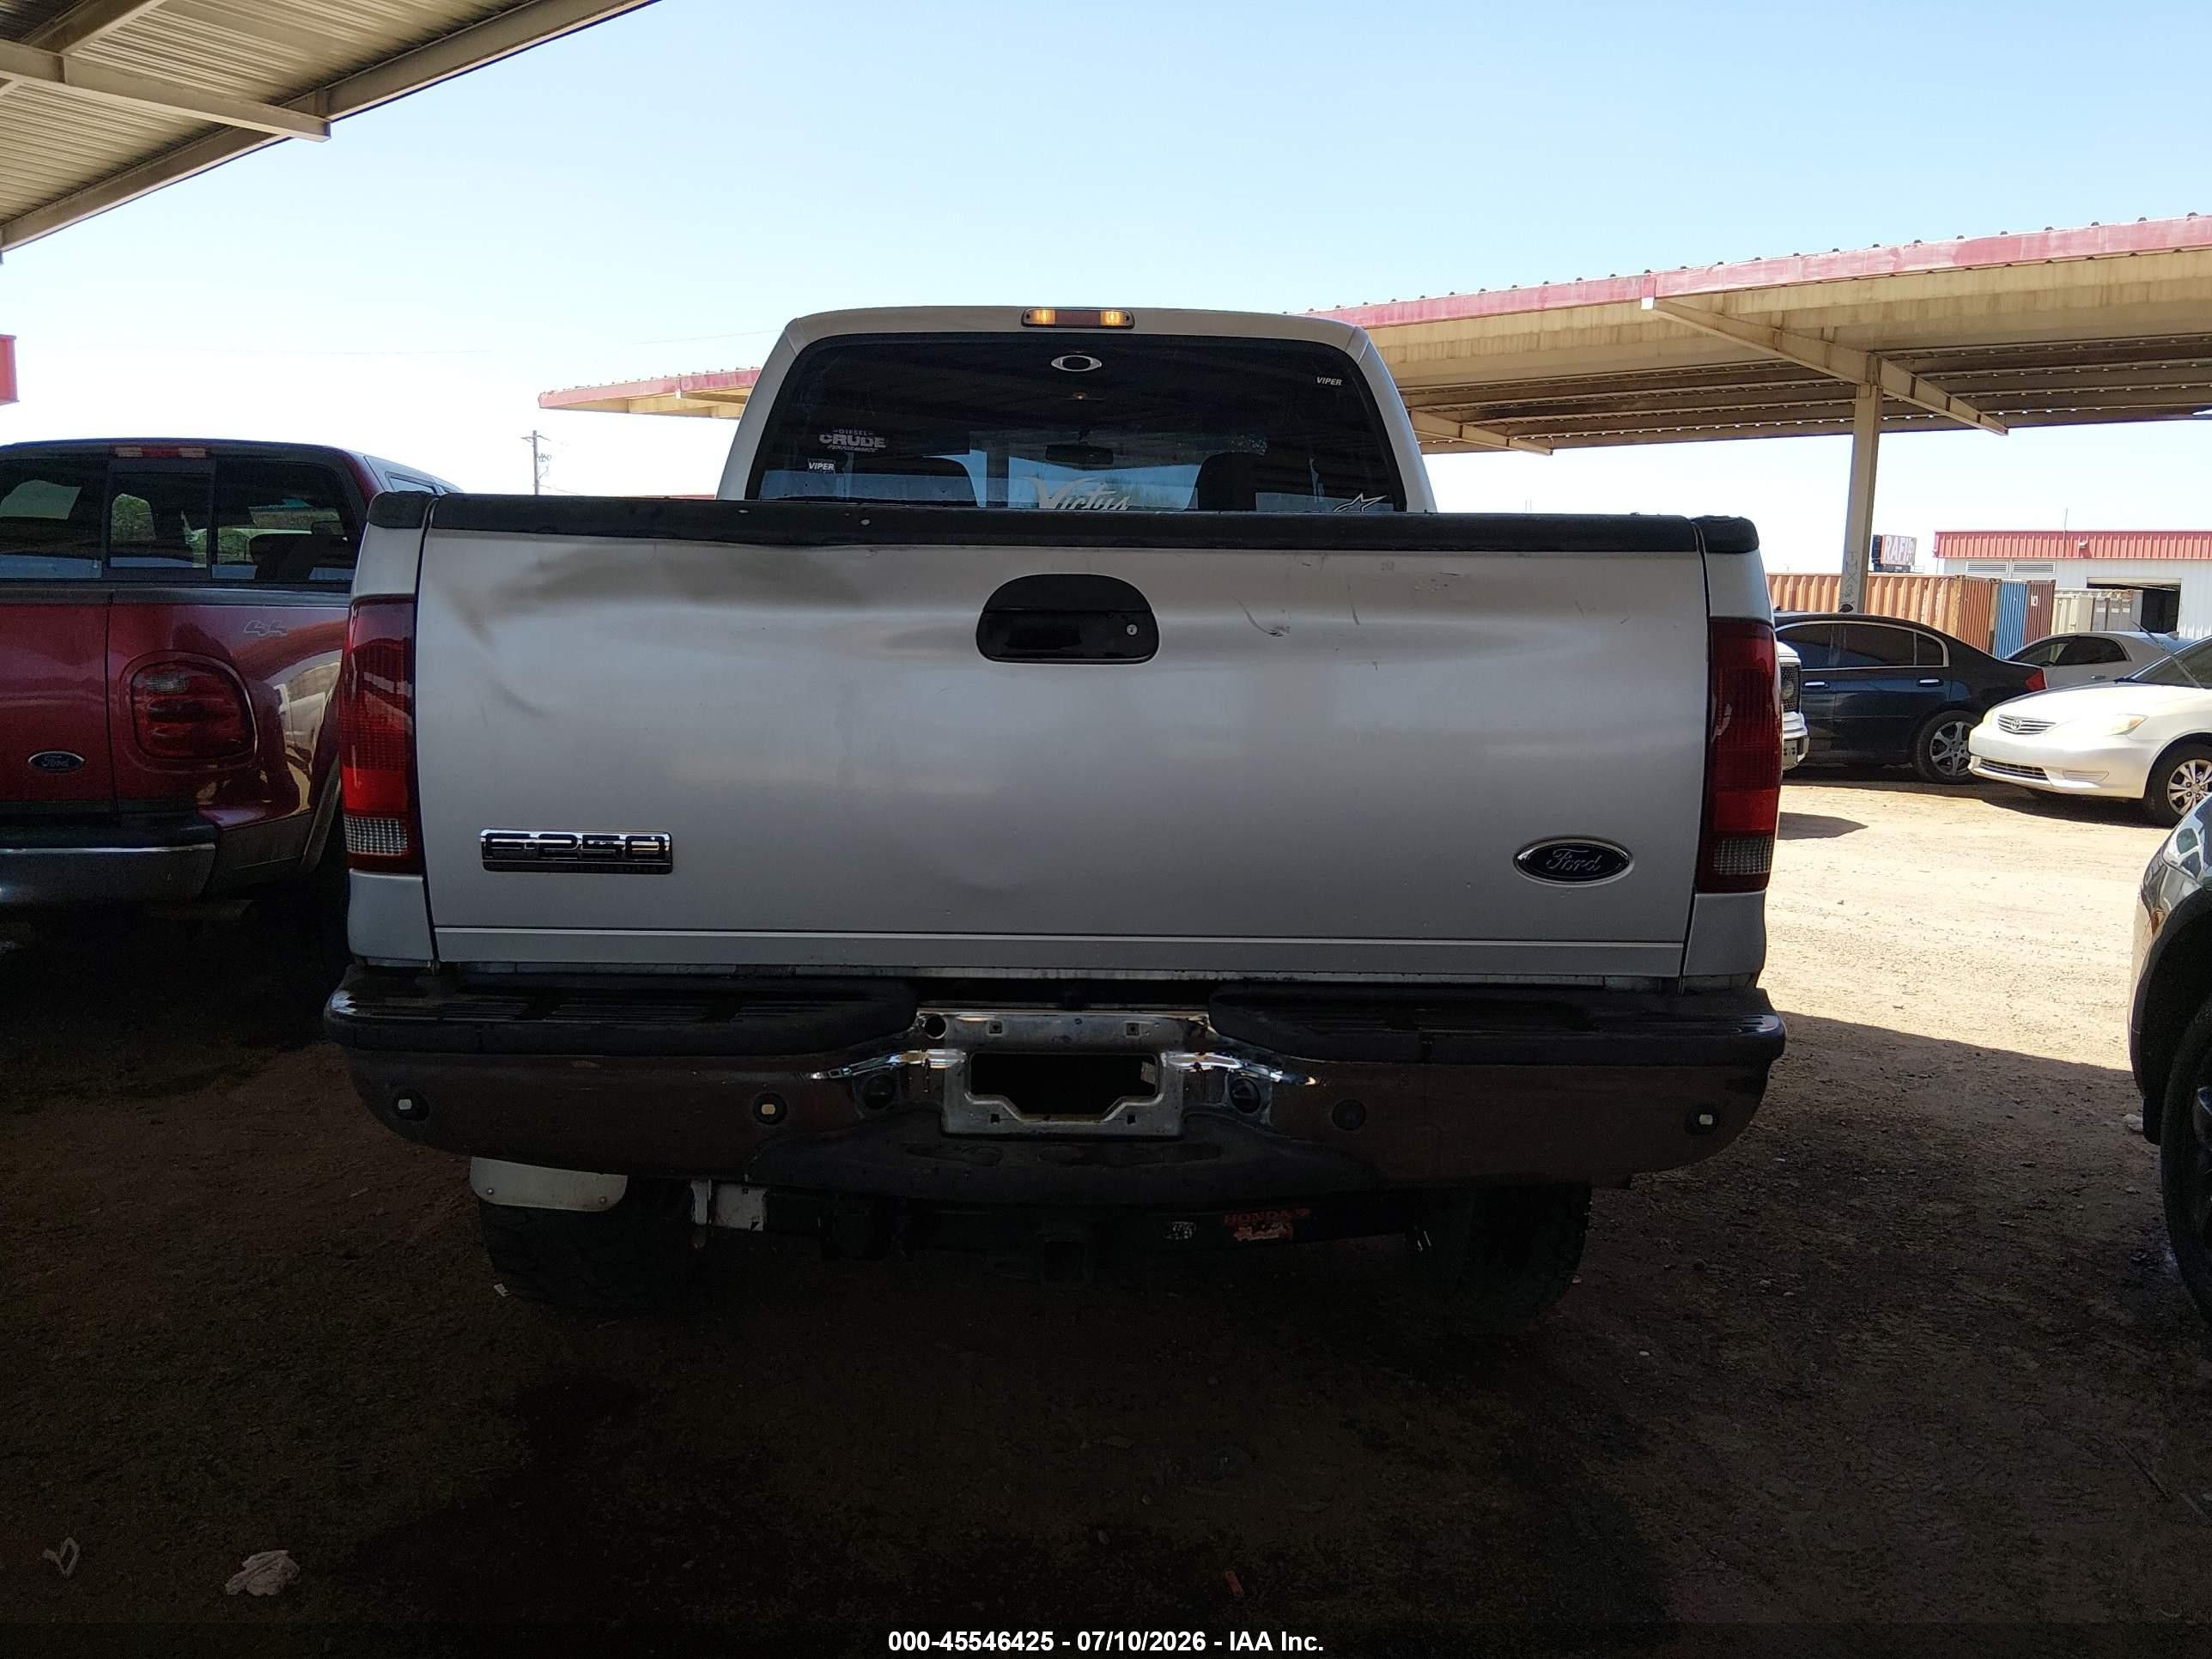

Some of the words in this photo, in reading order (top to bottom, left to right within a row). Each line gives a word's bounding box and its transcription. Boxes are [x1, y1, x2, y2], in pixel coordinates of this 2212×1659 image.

[1316, 376, 1342, 386] VIPER
[818, 434, 886, 448] CRUDE
[808, 462, 834, 471] VIPER
[1546, 848, 1602, 872] Ford
